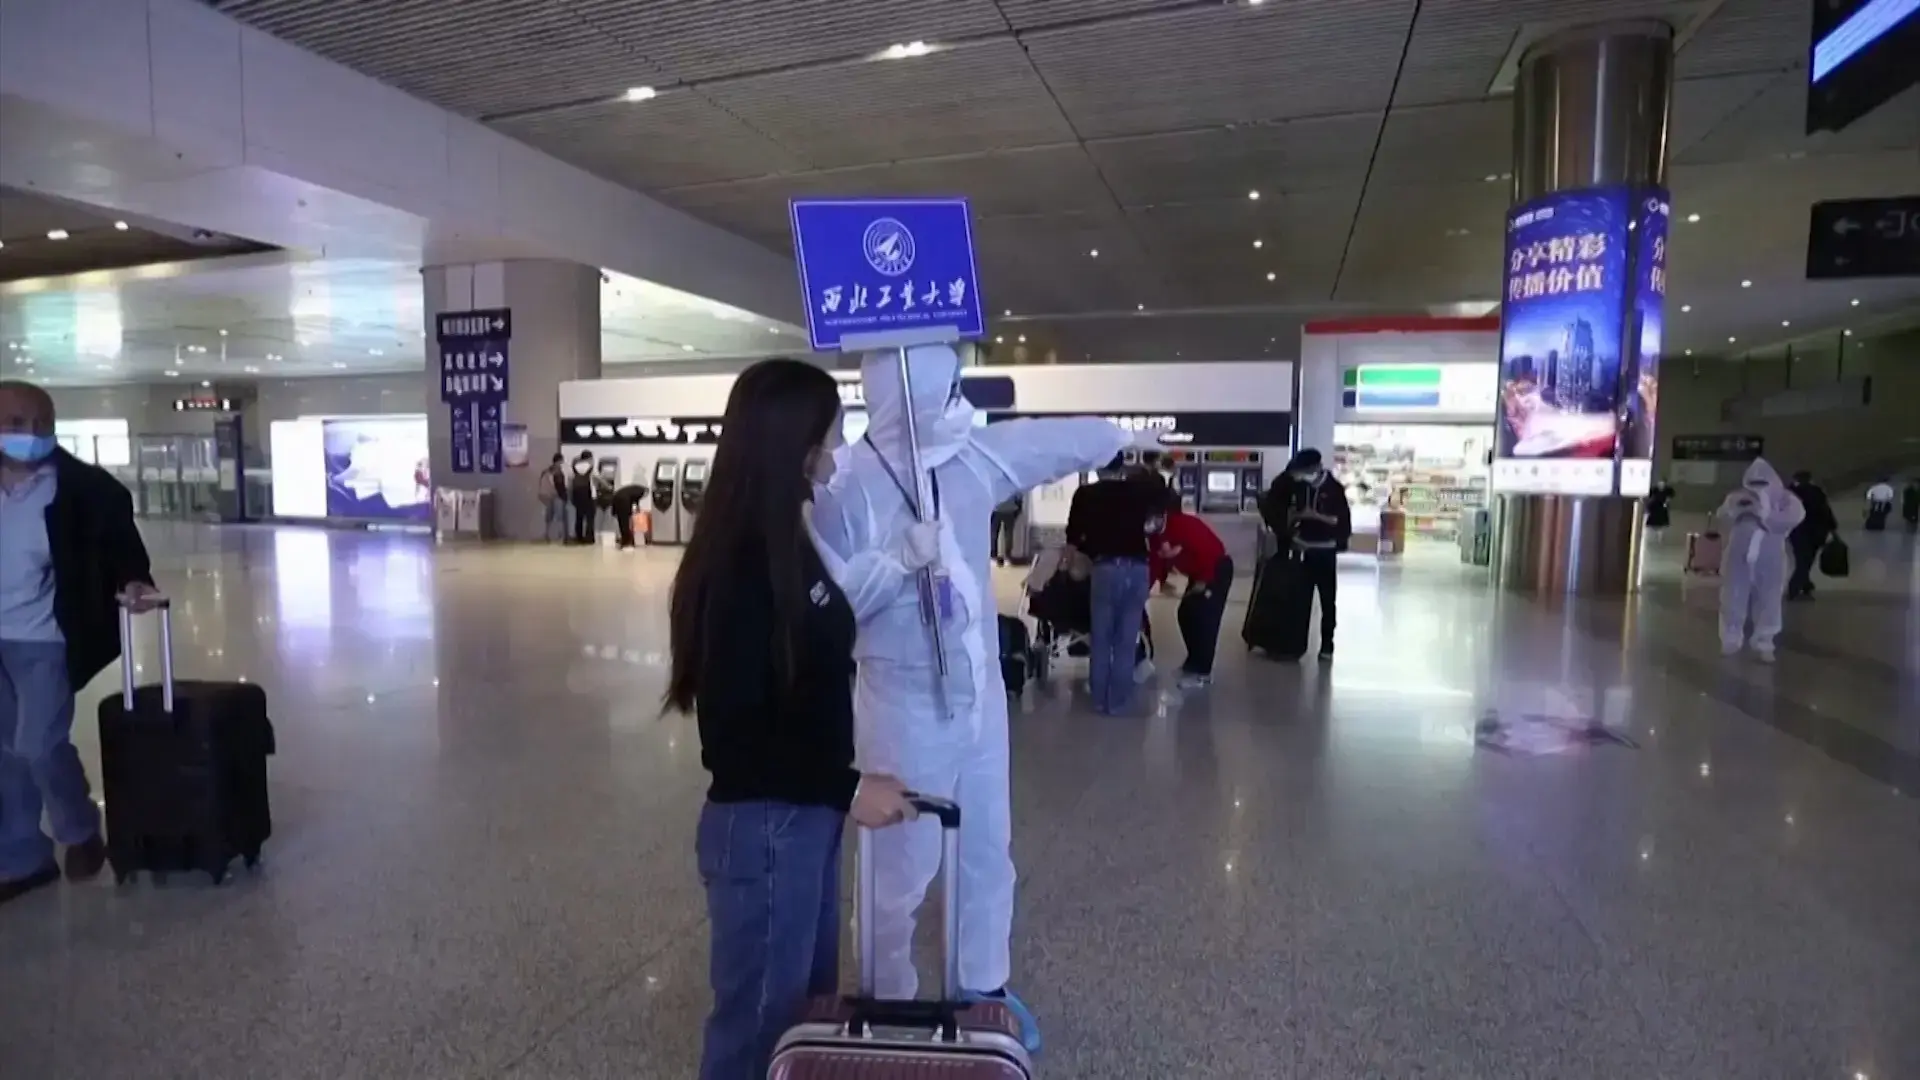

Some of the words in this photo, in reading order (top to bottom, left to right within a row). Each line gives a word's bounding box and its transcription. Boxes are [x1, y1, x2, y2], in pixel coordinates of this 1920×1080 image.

[1511, 233, 1606, 272] 分享精彩
[1509, 264, 1604, 301] 传播价值
